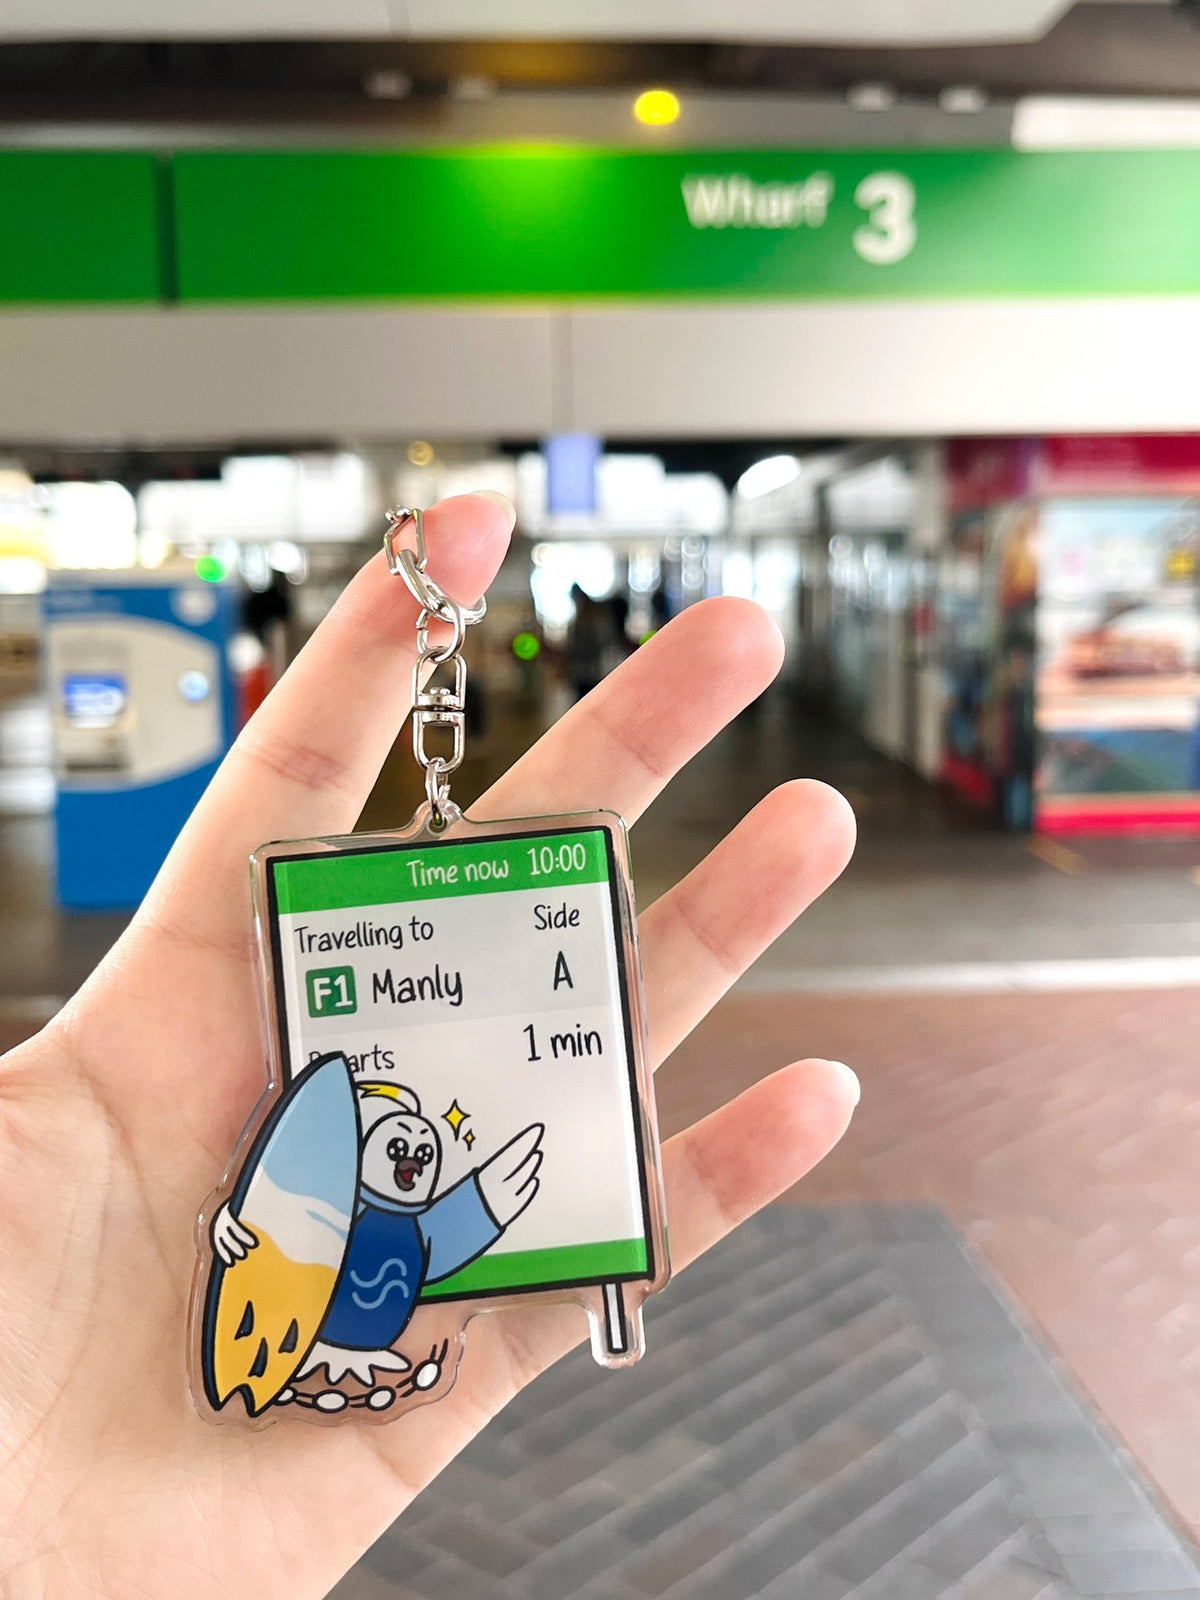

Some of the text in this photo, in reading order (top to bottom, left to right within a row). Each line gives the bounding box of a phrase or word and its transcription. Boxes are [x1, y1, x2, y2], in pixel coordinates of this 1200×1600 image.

[853, 170, 916, 264] 3
[407, 843, 587, 888] Time now 10:00
[294, 916, 434, 954] Travelling to
[534, 902, 580, 931] Side
[313, 964, 463, 1011] F1 Manly
[553, 950, 574, 991] A
[523, 1024, 602, 1062] 1 min
